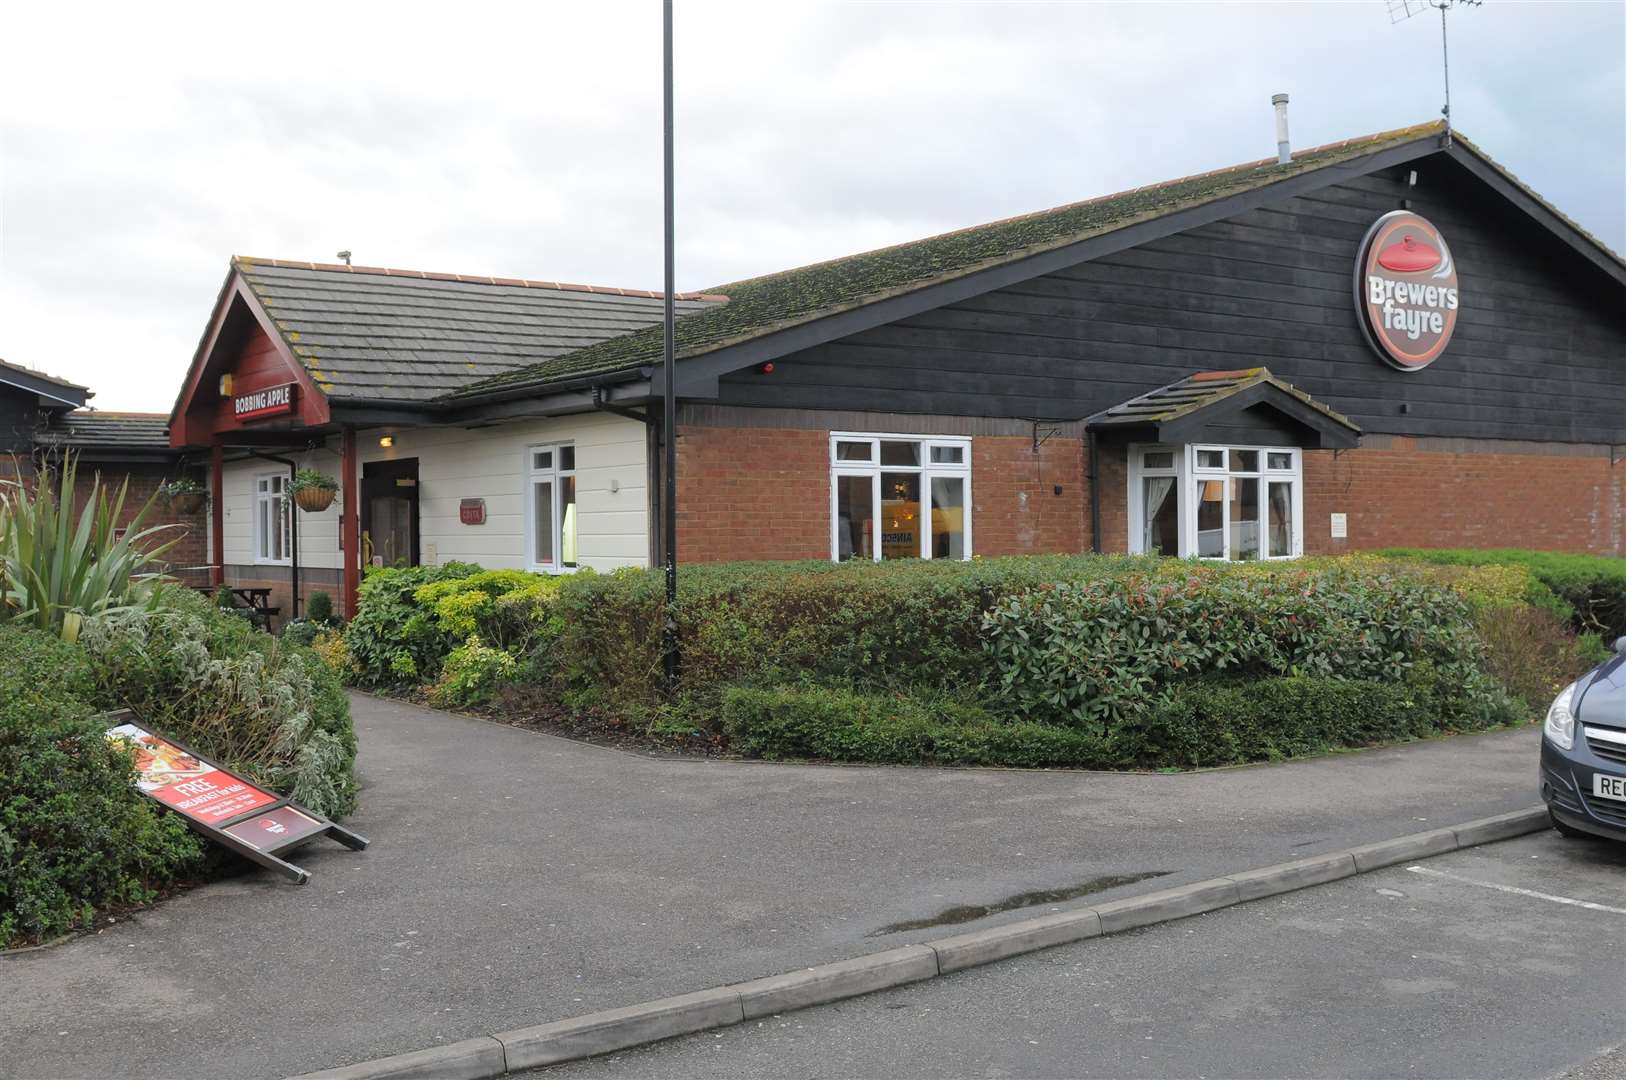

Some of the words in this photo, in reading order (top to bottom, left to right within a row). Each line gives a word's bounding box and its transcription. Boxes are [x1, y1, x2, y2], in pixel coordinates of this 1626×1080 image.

[1368, 276, 1459, 310] Brewers
[1383, 297, 1443, 340] fayre
[235, 393, 266, 414] BOBBING
[267, 387, 289, 408] APPLE
[173, 778, 218, 797] FREE
[1601, 776, 1626, 797] RE
